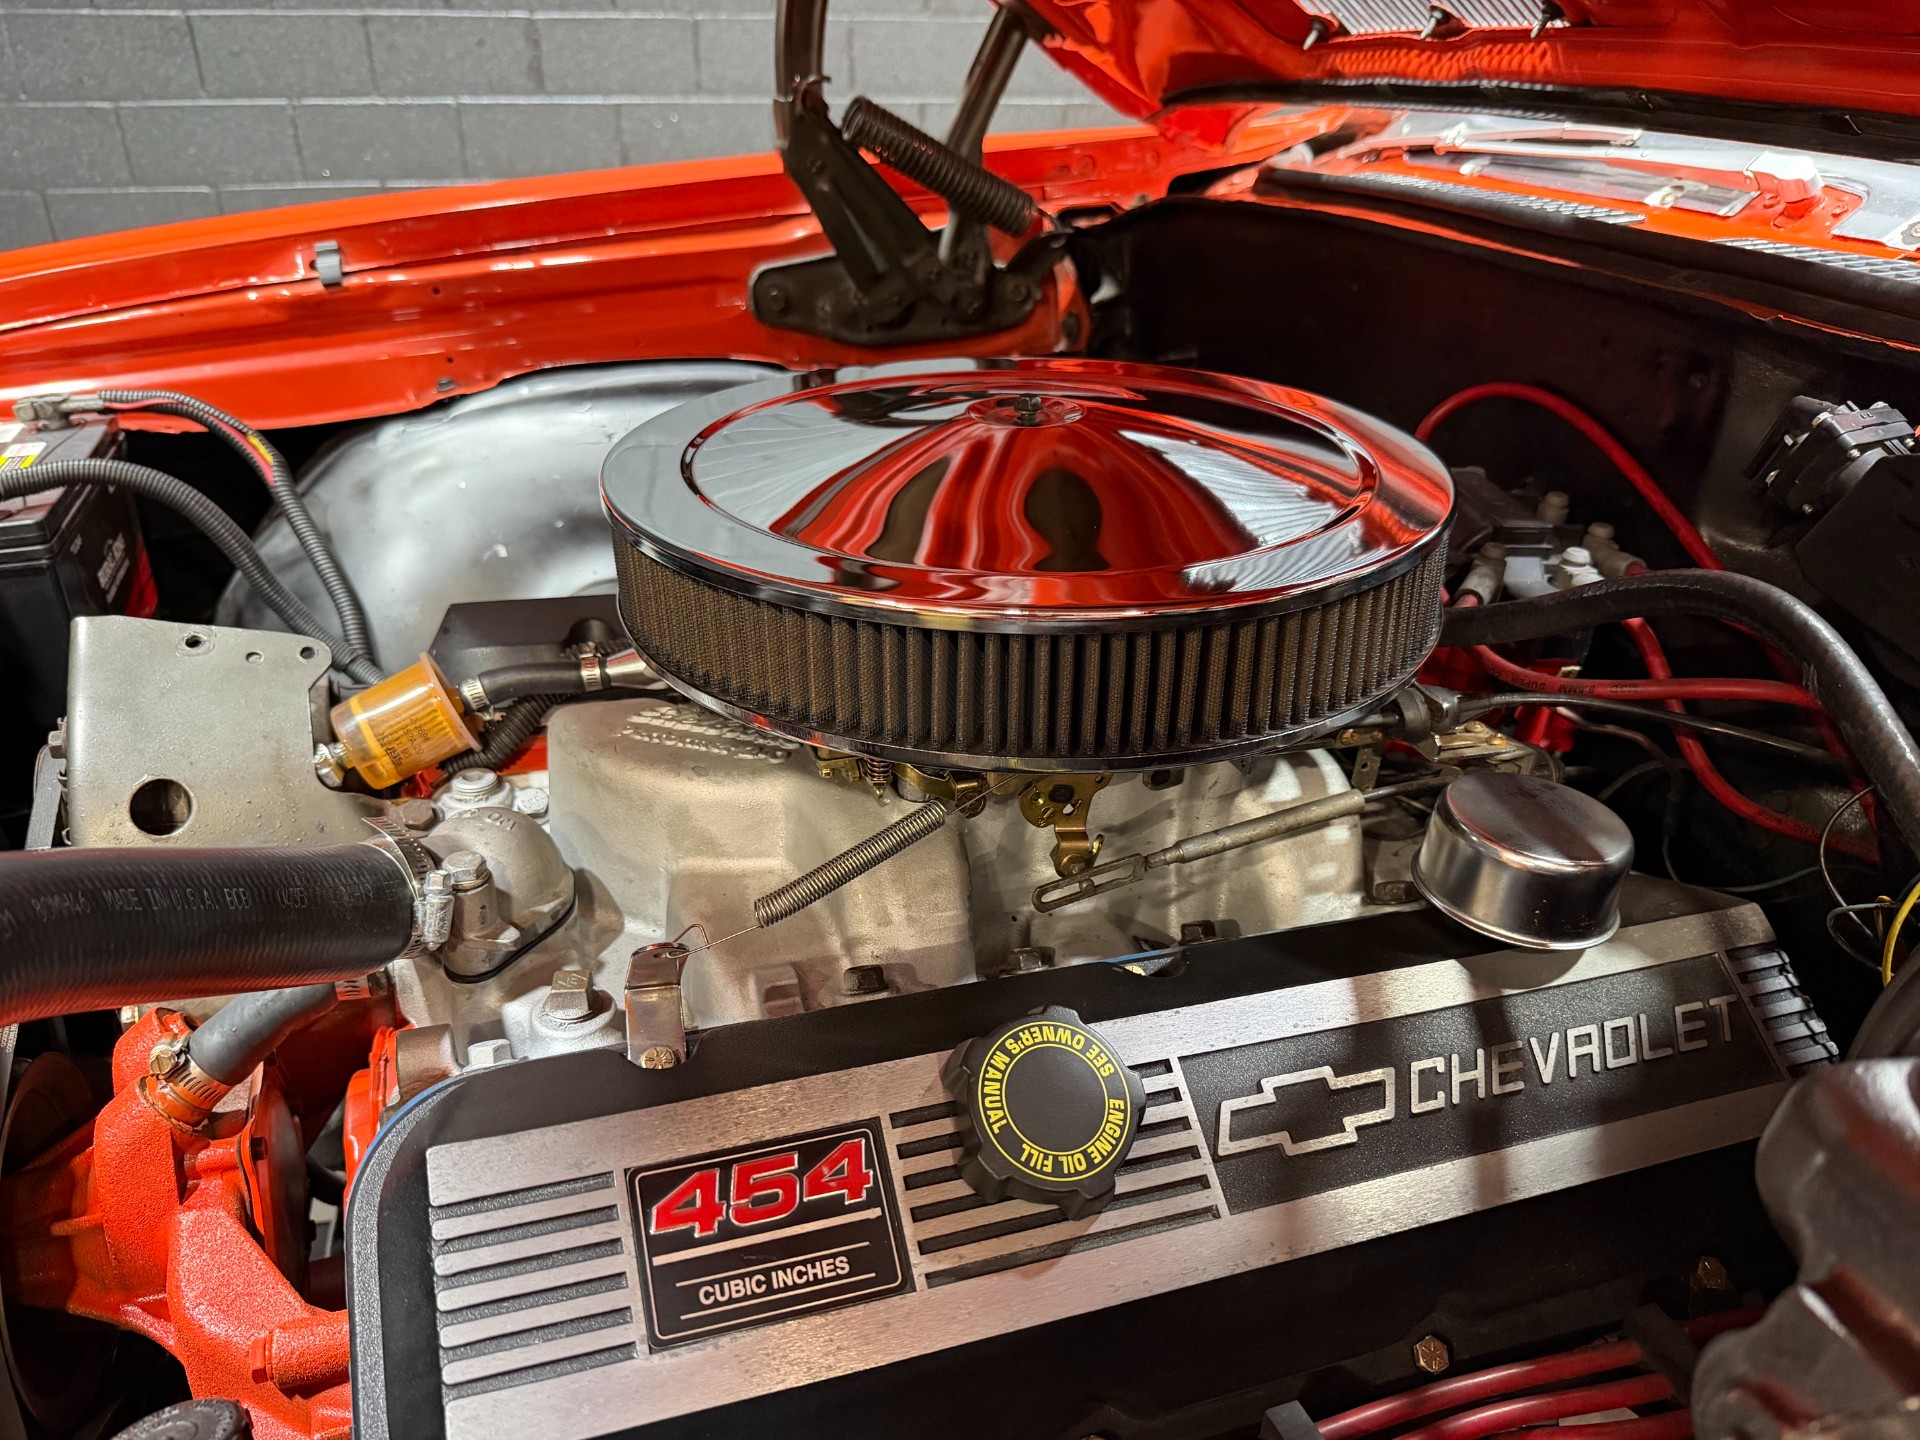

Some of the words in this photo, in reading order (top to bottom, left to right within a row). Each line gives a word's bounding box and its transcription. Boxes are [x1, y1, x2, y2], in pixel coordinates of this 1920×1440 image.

[1510, 675, 1547, 691] SUPER
[102, 888, 143, 911] MADE
[145, 888, 169, 911] IN
[169, 888, 219, 911] U.S.A.
[1004, 1026, 1086, 1055] OWNER'S
[1410, 995, 1737, 1114] CHEVROLET
[1085, 1044, 1115, 1077] SEE
[983, 1050, 1011, 1135] MANUAL
[1087, 1098, 1125, 1164] ENGINE
[1020, 1143, 1053, 1174] FILL
[1058, 1153, 1087, 1174] OIL
[650, 1137, 873, 1238] 454
[699, 1277, 767, 1305] CUBIC
[771, 1256, 850, 1290] INCHES
